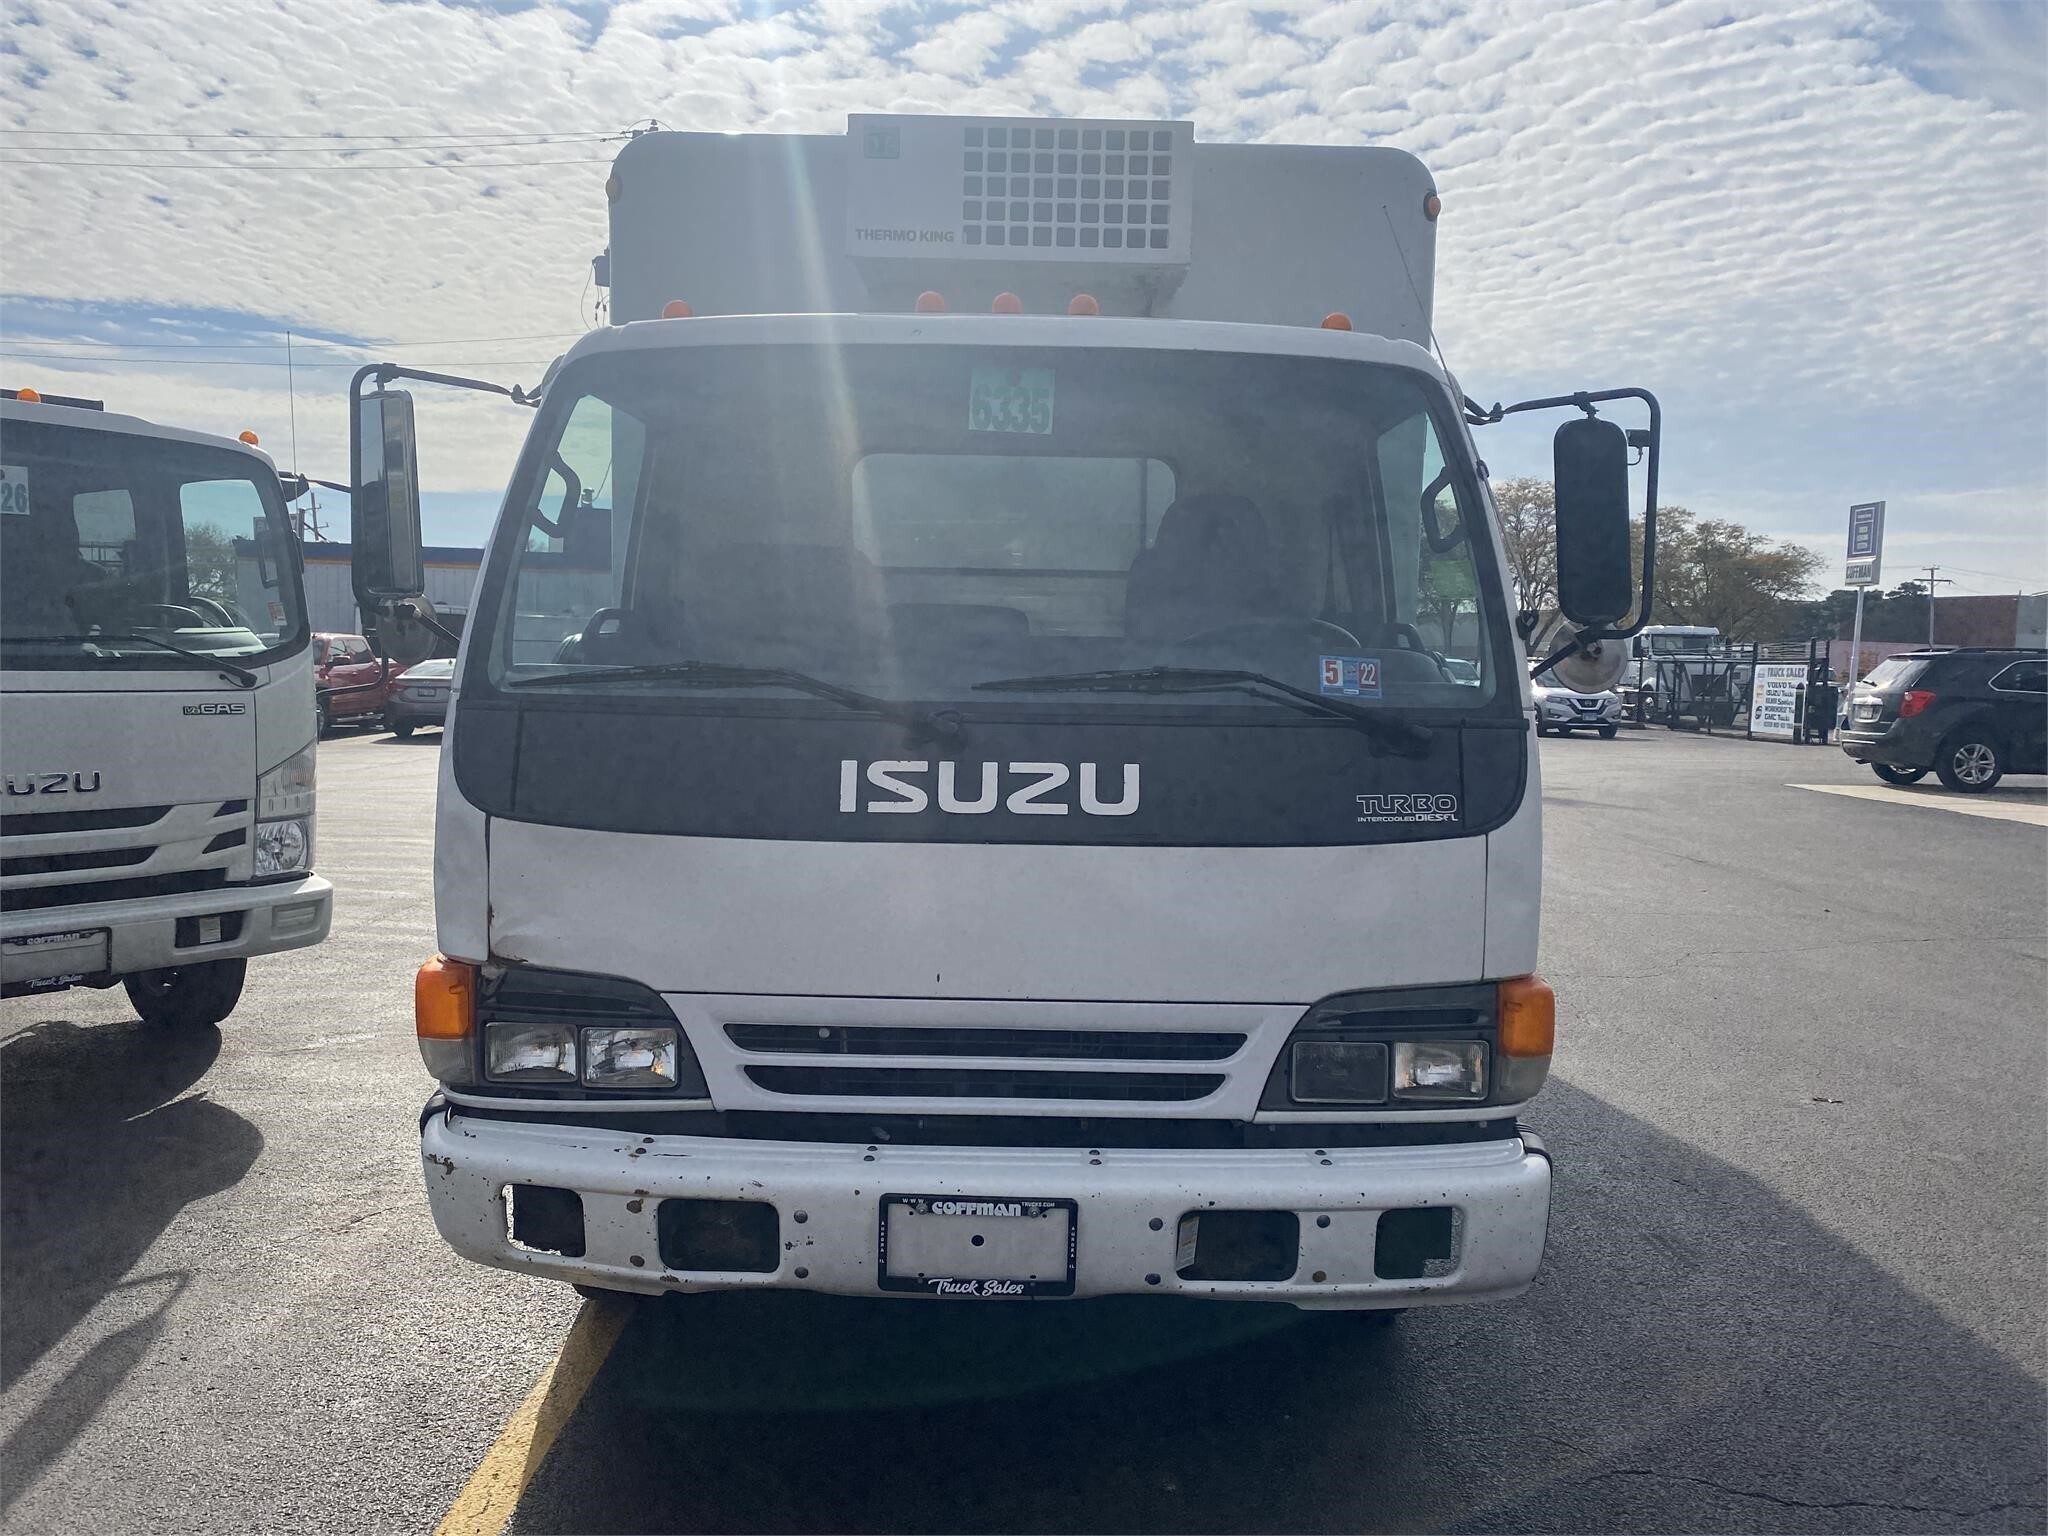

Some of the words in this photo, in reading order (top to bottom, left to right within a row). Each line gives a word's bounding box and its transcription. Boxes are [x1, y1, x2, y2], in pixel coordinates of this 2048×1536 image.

[855, 228, 916, 241] THERMO
[919, 231, 955, 242] KING
[974, 384, 1050, 432] 6335
[1325, 660, 1339, 685] 5
[1360, 663, 1376, 686] 22
[1767, 667, 1786, 678] TRUCK
[1786, 667, 1805, 679] SALES
[200, 703, 245, 715] GAS
[0, 771, 100, 796] UZU
[839, 760, 1140, 816] ISUZU
[1356, 793, 1457, 814] TURBO
[1415, 813, 1459, 822] DIESEL
[931, 1201, 1022, 1216] COFFMAN
[927, 1278, 980, 1296] Truck
[981, 1279, 1024, 1296] Sales
